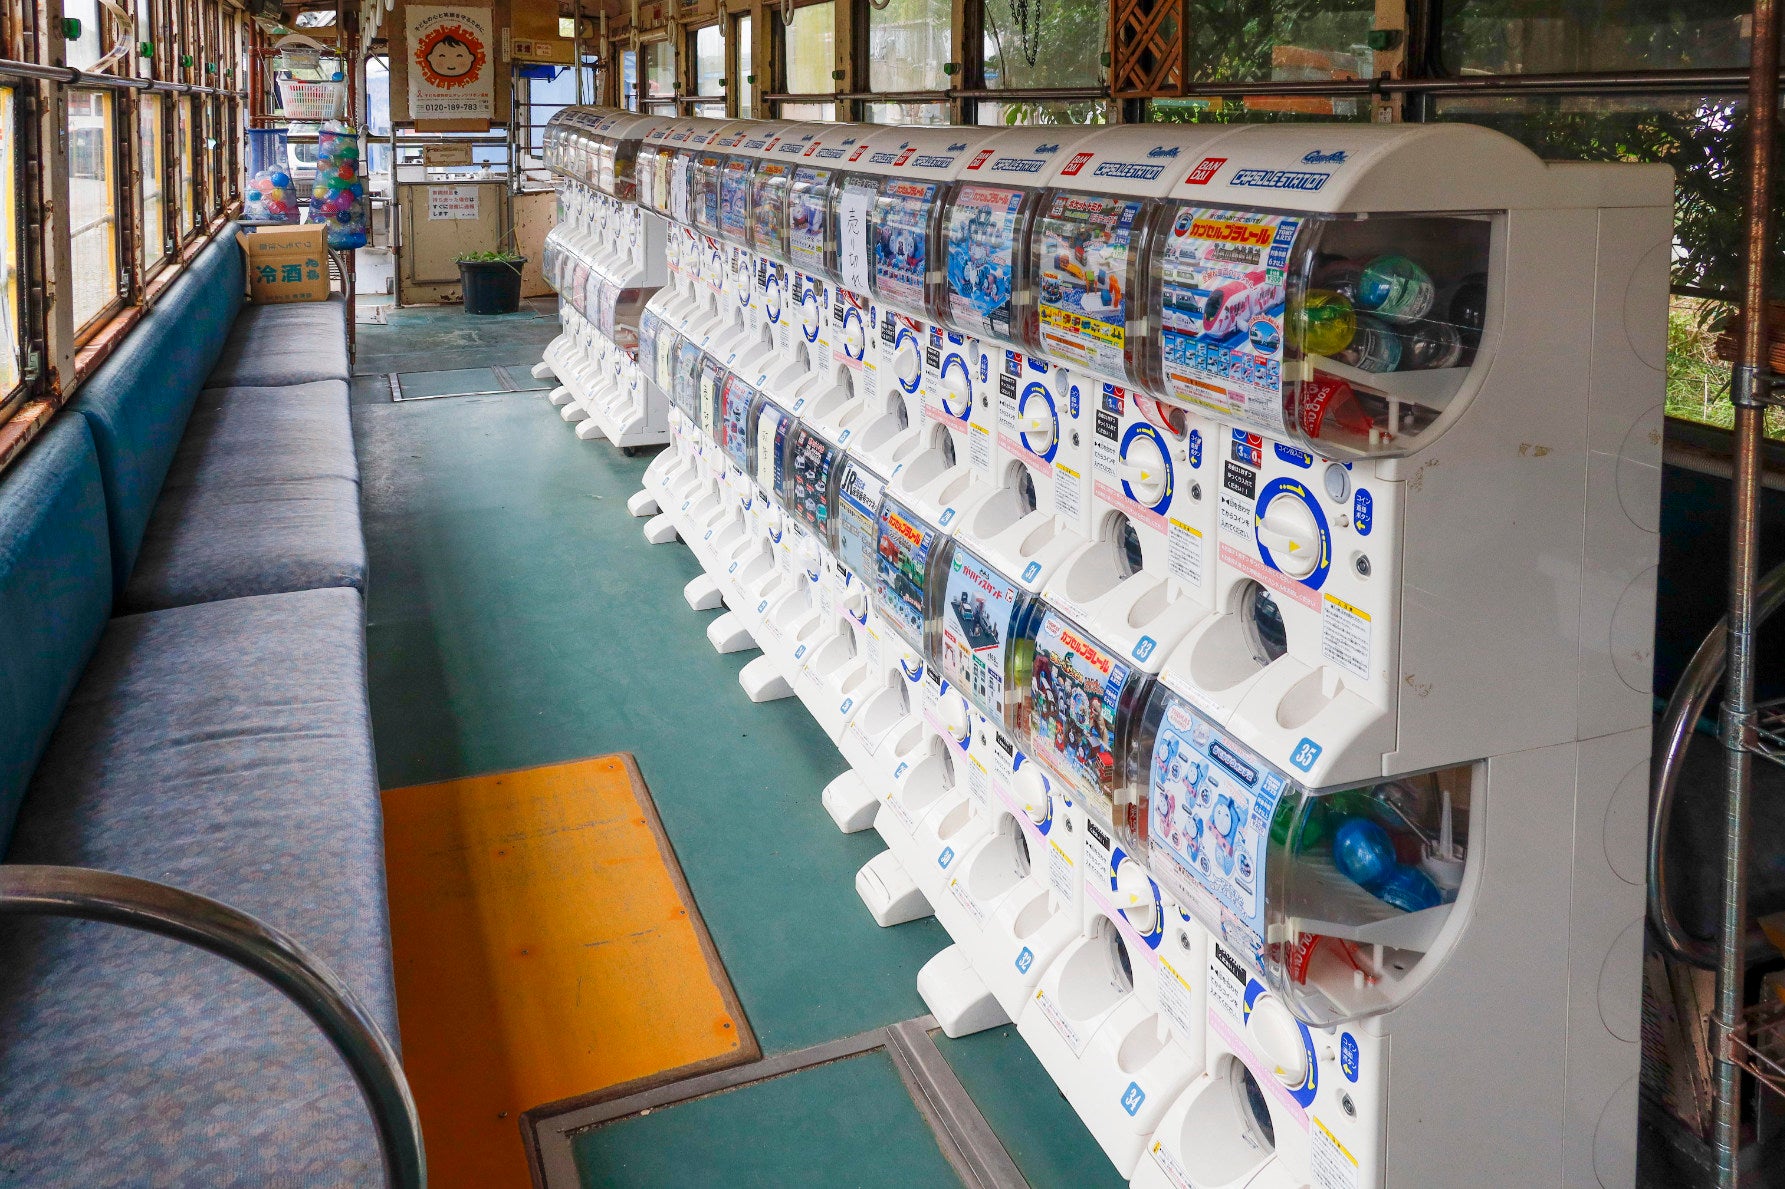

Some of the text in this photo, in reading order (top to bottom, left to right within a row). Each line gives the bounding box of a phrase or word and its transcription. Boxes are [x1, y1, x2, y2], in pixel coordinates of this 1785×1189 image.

[1190, 170, 1211, 180] DAI
[1199, 161, 1222, 171] BAN
[1190, 222, 1272, 245] カプセルプラレール
[256, 264, 302, 284] 冷酒
[1060, 631, 1110, 673] カプセルプラレール
[1136, 640, 1152, 658] 33
[1295, 743, 1318, 767] 35
[1017, 951, 1032, 971] 32
[1125, 1086, 1139, 1111] 34
